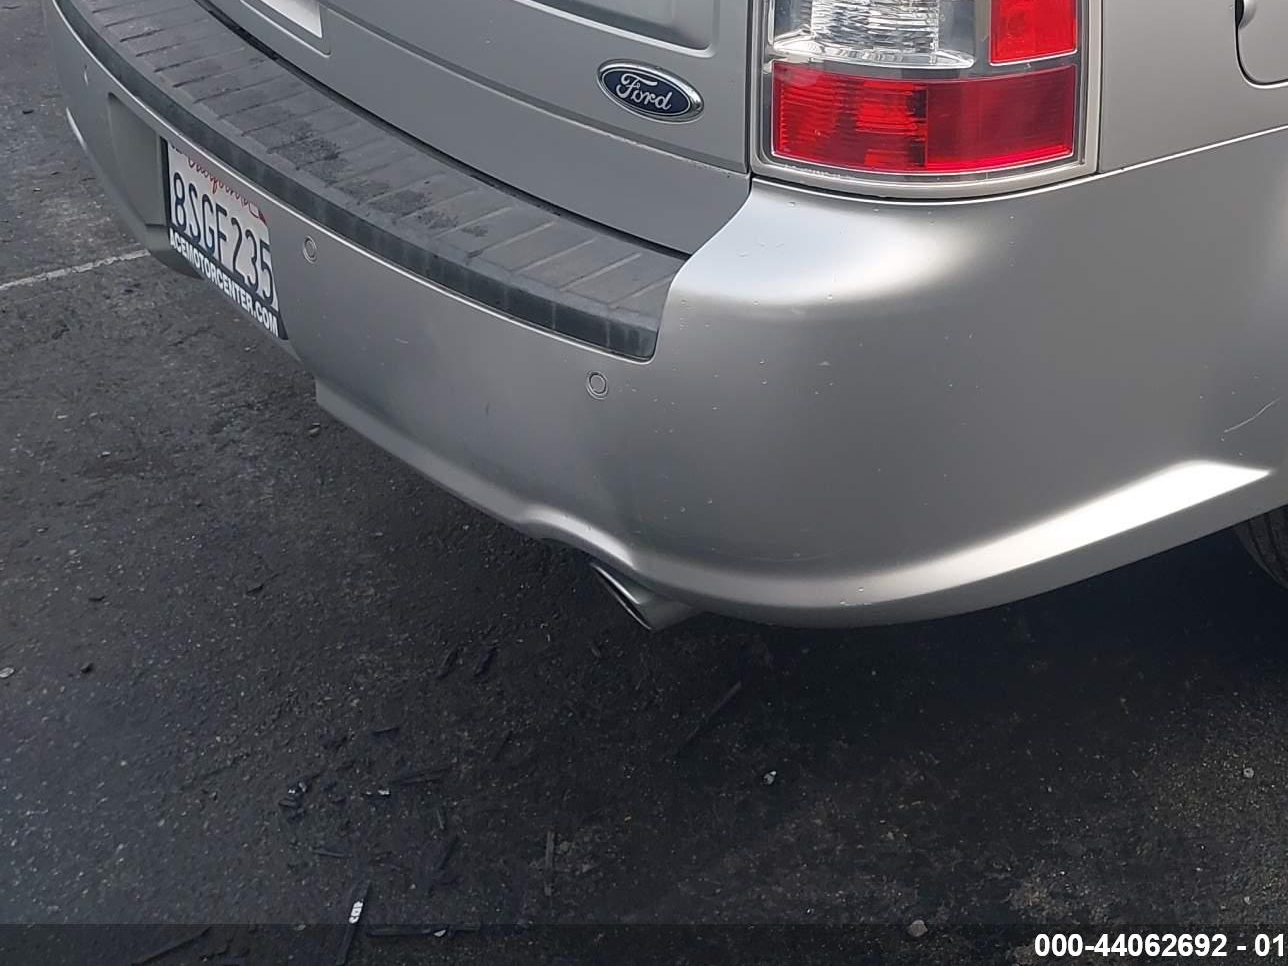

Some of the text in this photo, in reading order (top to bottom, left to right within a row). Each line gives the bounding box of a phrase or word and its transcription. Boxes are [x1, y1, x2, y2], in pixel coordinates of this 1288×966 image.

[615, 73, 673, 110] Ford
[169, 231, 280, 339] ACEMOTORCENTER.COM
[173, 171, 274, 306] 8SGF235
